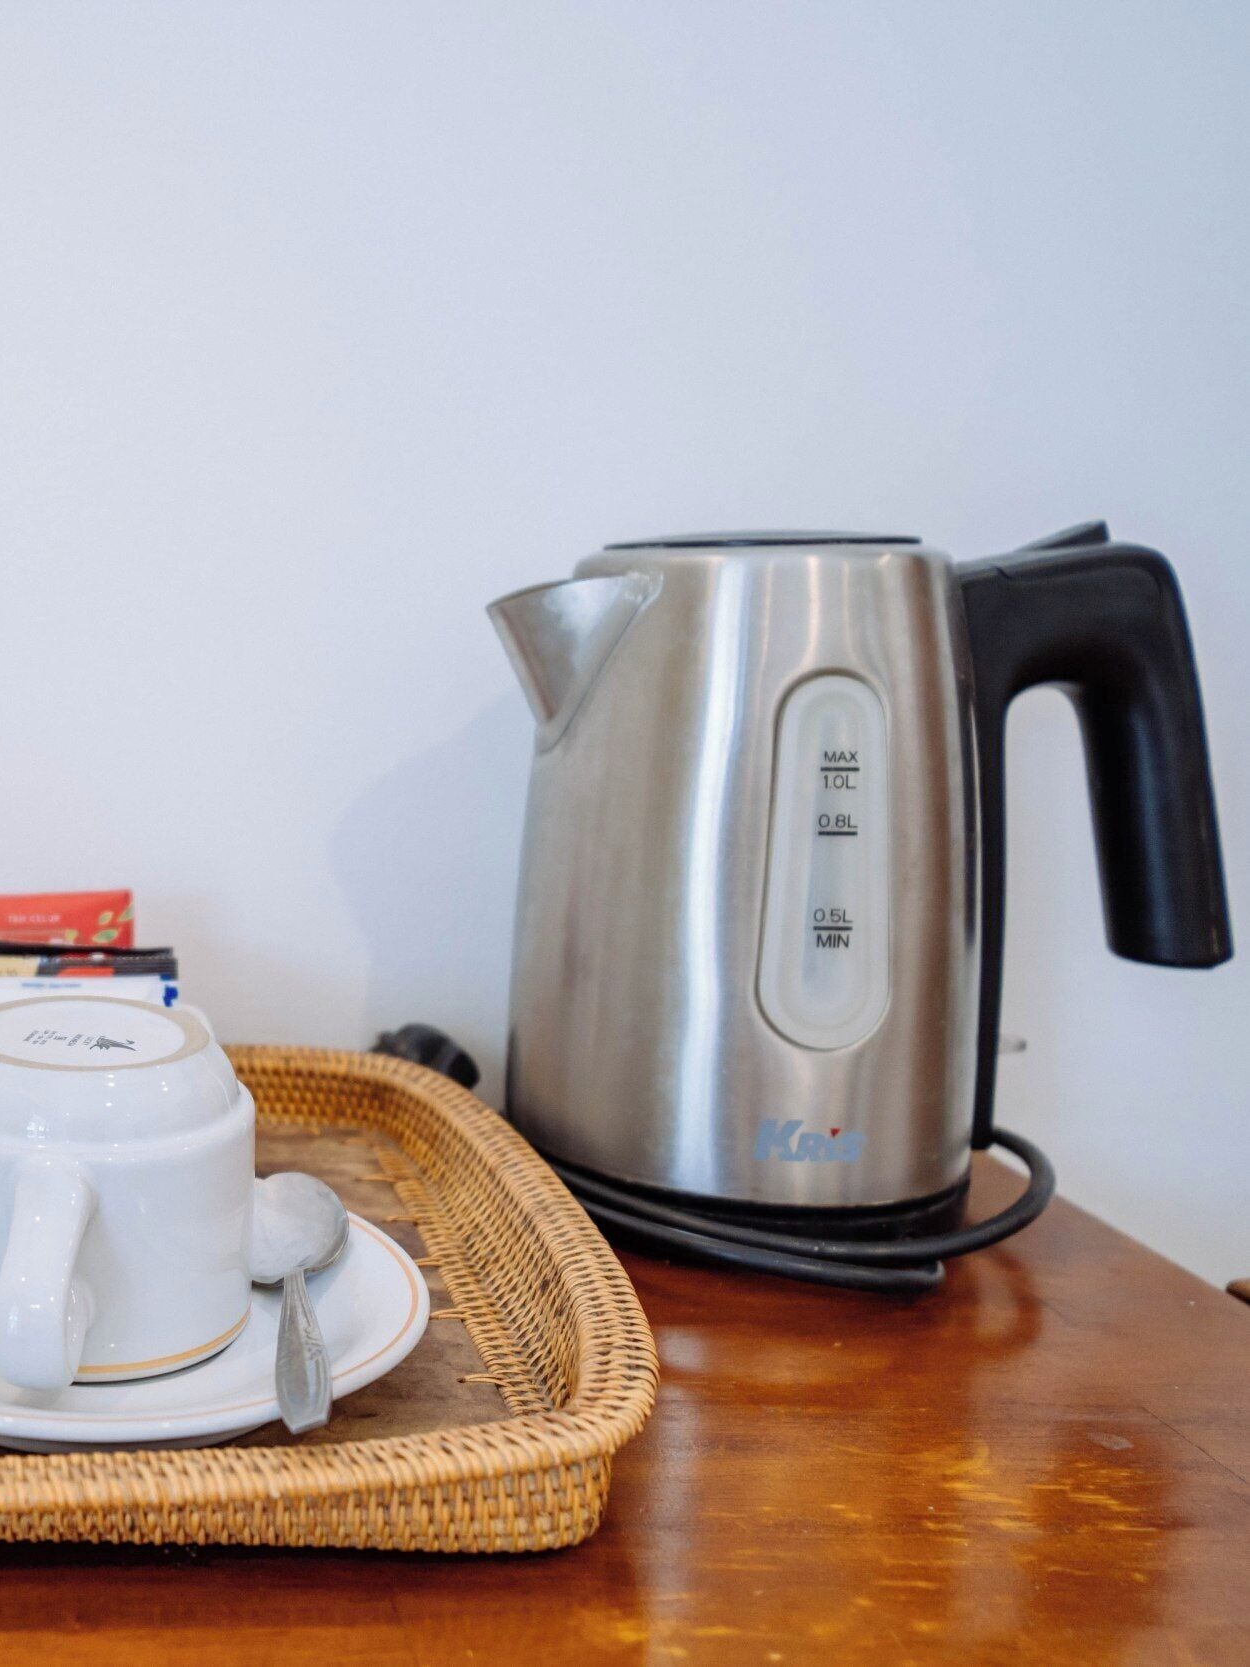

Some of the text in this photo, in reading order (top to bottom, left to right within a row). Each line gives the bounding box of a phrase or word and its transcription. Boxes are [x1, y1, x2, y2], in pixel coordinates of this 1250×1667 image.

[823, 751, 858, 763] MAX
[823, 774, 857, 789] 1.0L
[817, 813, 858, 829] 0.8L
[813, 908, 853, 923] 0.5L
[816, 933, 850, 948] MIN
